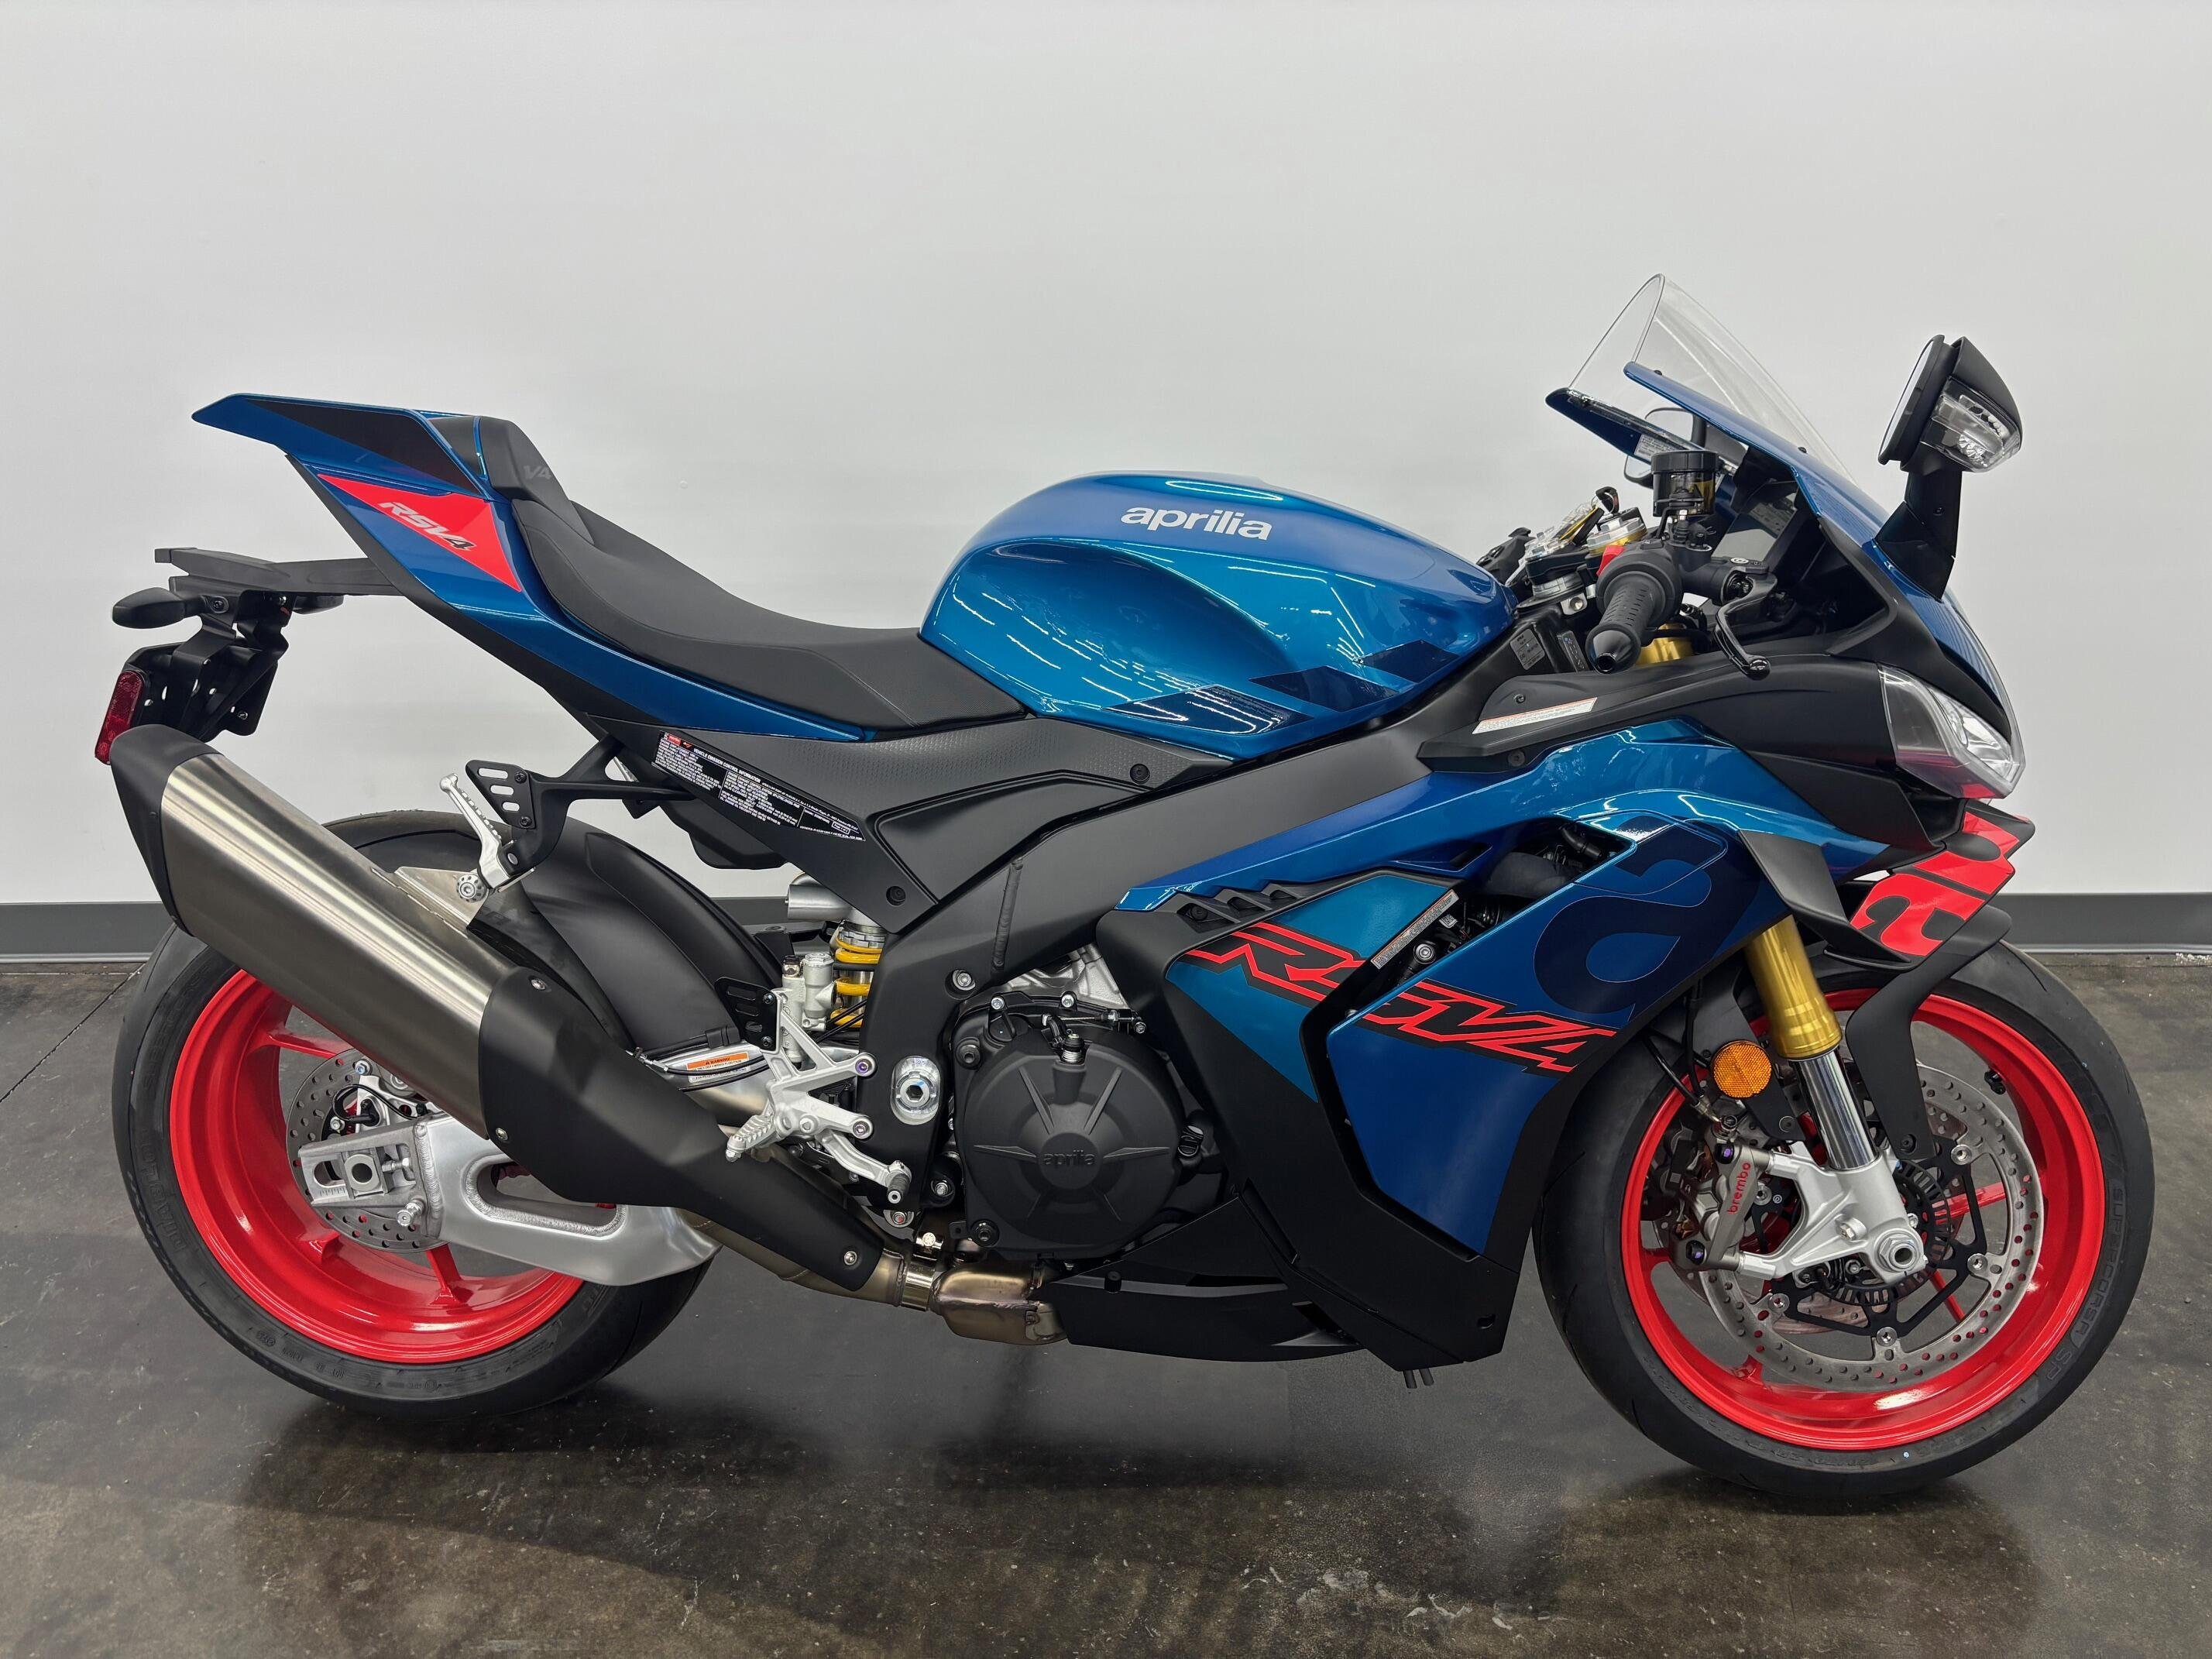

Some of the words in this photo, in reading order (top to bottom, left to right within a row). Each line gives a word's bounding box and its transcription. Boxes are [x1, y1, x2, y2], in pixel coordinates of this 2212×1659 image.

[522, 464, 551, 479] V4
[377, 500, 476, 550] RSV4
[1121, 506, 1273, 541] aprilia
[692, 747, 708, 758] VEHICLE
[722, 761, 739, 772] CONTROL
[737, 768, 761, 784] INFORMATION
[1042, 1149, 1095, 1168] aprilia
[1725, 1160, 1753, 1216] brembo
[2046, 1349, 2071, 1380] SP
